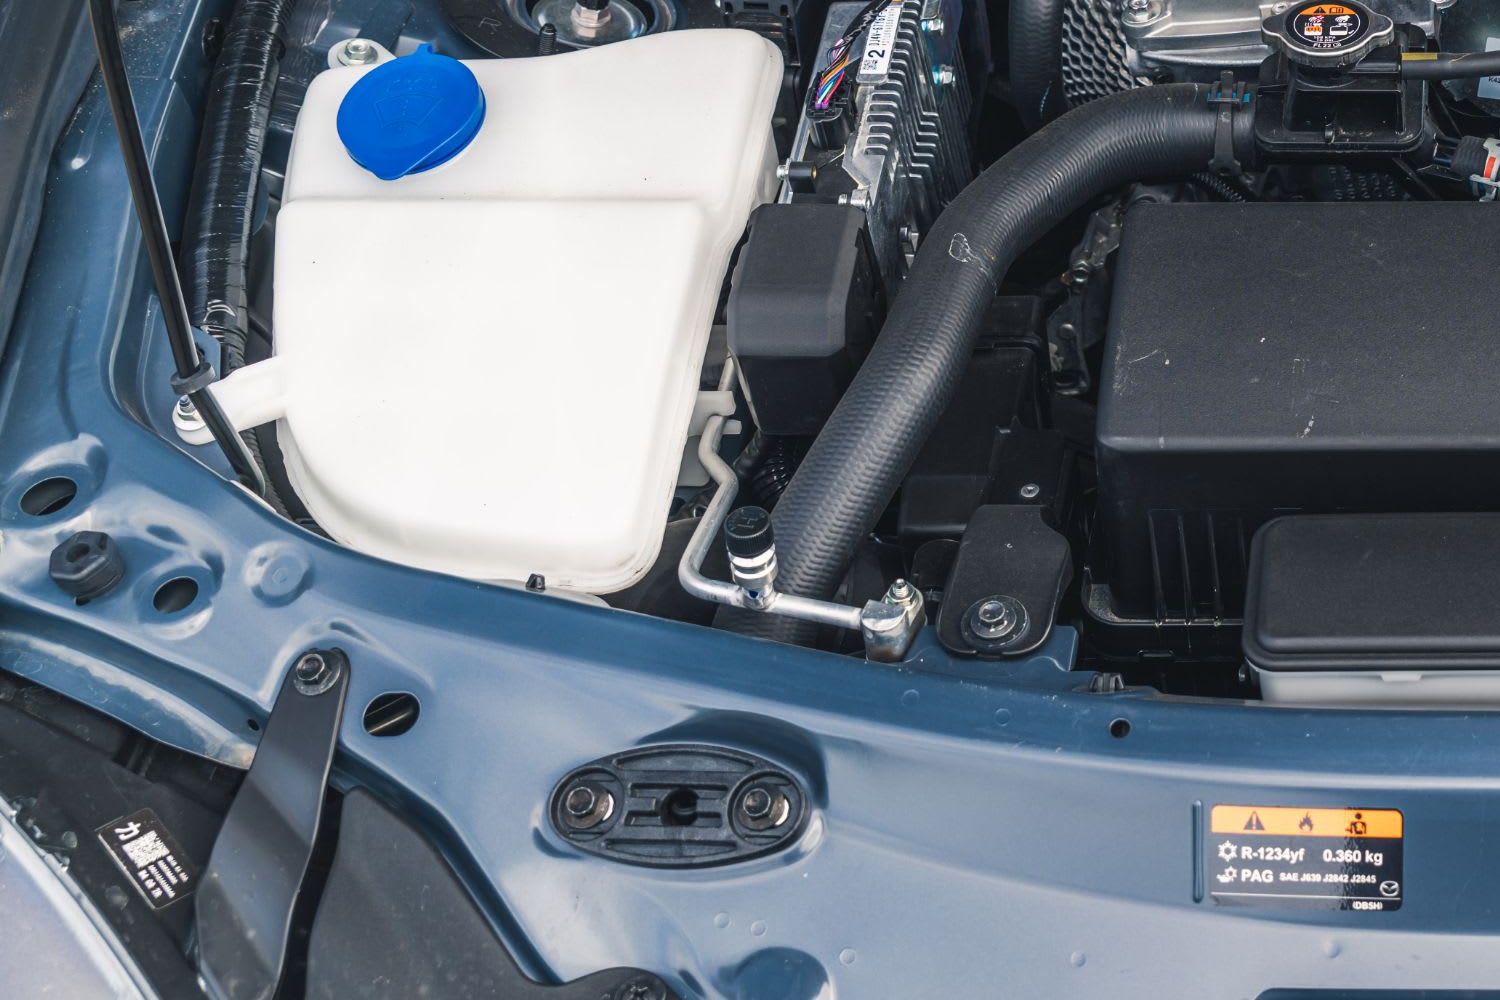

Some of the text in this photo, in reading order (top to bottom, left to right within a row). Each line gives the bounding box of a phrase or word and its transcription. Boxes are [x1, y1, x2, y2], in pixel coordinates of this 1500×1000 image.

[868, 49, 885, 58] 2
[1241, 847, 1383, 866] R-1234yf 0.360 kg
[1241, 869, 1377, 883] PAG SAE J639 J2842 J2845
